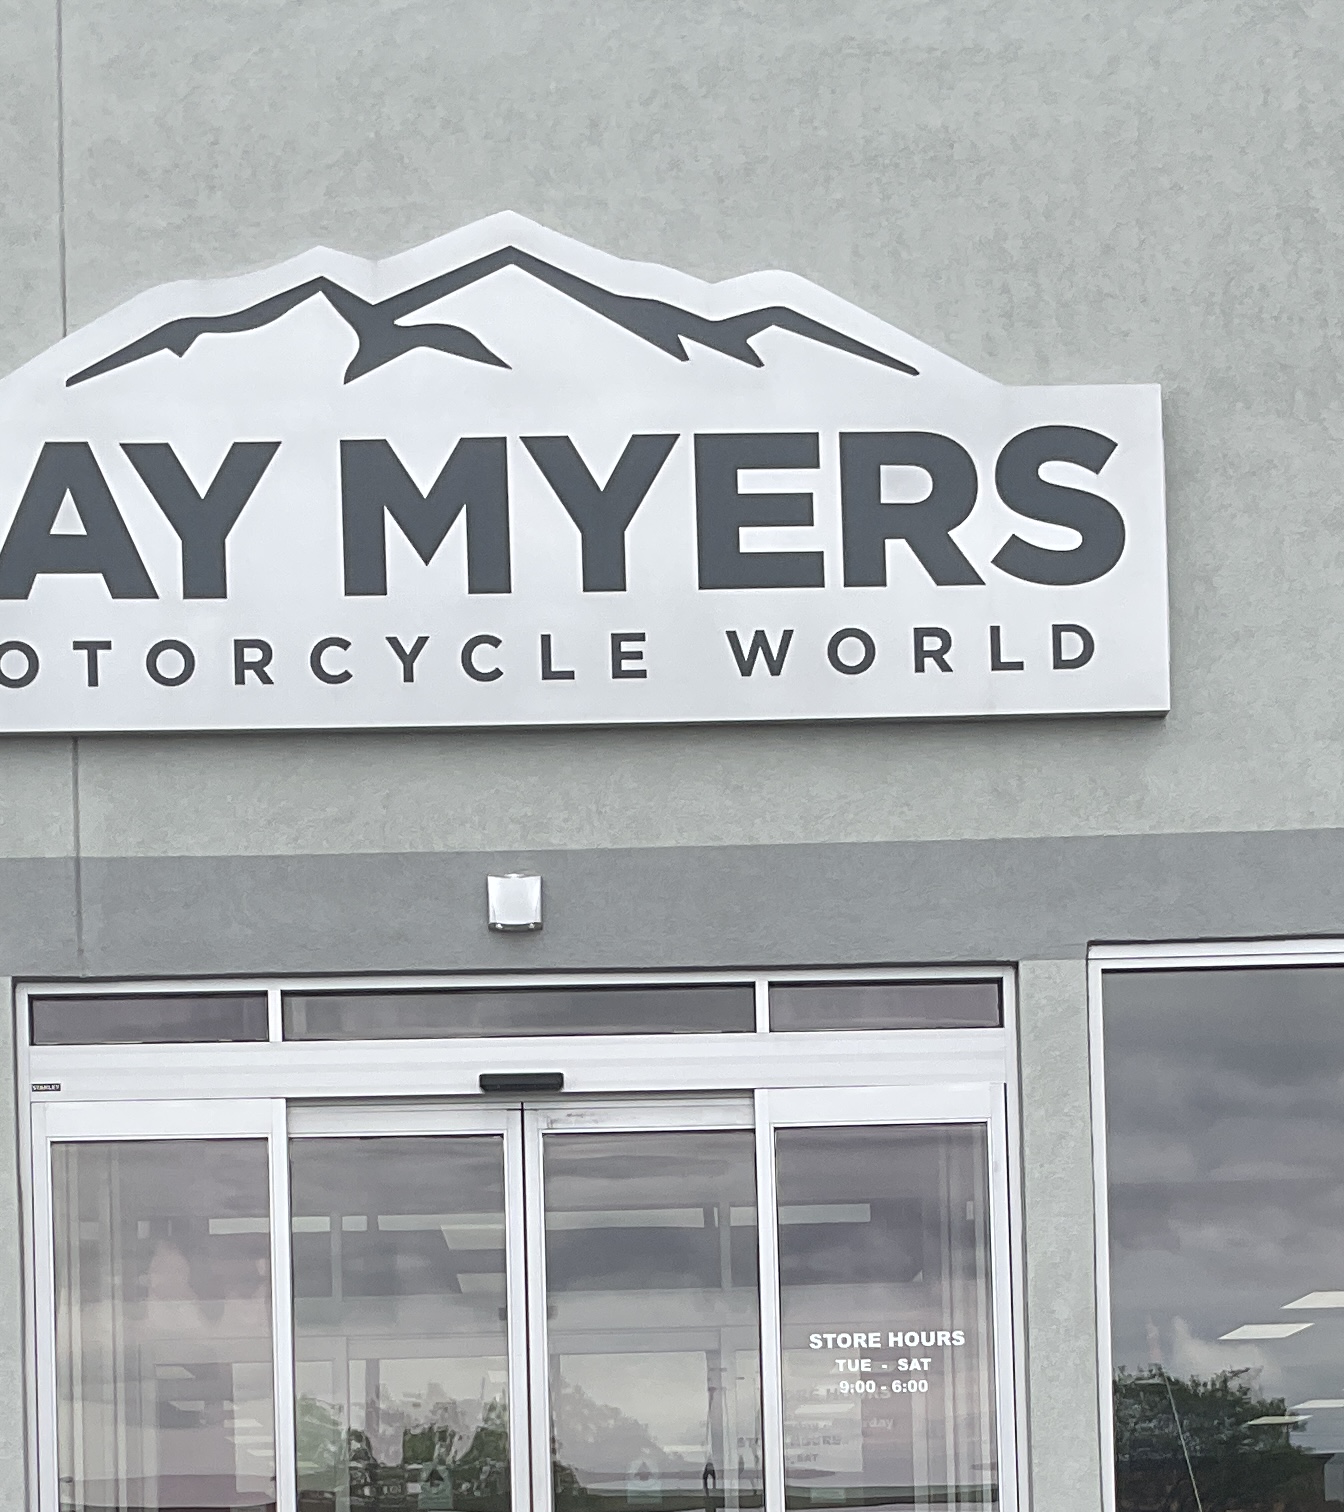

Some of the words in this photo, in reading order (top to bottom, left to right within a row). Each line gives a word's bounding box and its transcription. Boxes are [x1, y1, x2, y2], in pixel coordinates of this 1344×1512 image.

[340, 424, 1126, 597] MYERS
[725, 622, 1096, 679] WORLD
[809, 1332, 882, 1350] STORE
[888, 1330, 966, 1348] HOURS
[835, 1358, 872, 1372] TUE
[897, 1357, 932, 1371] SAT
[839, 1379, 876, 1394] 9:00
[891, 1379, 929, 1393] 6:00
